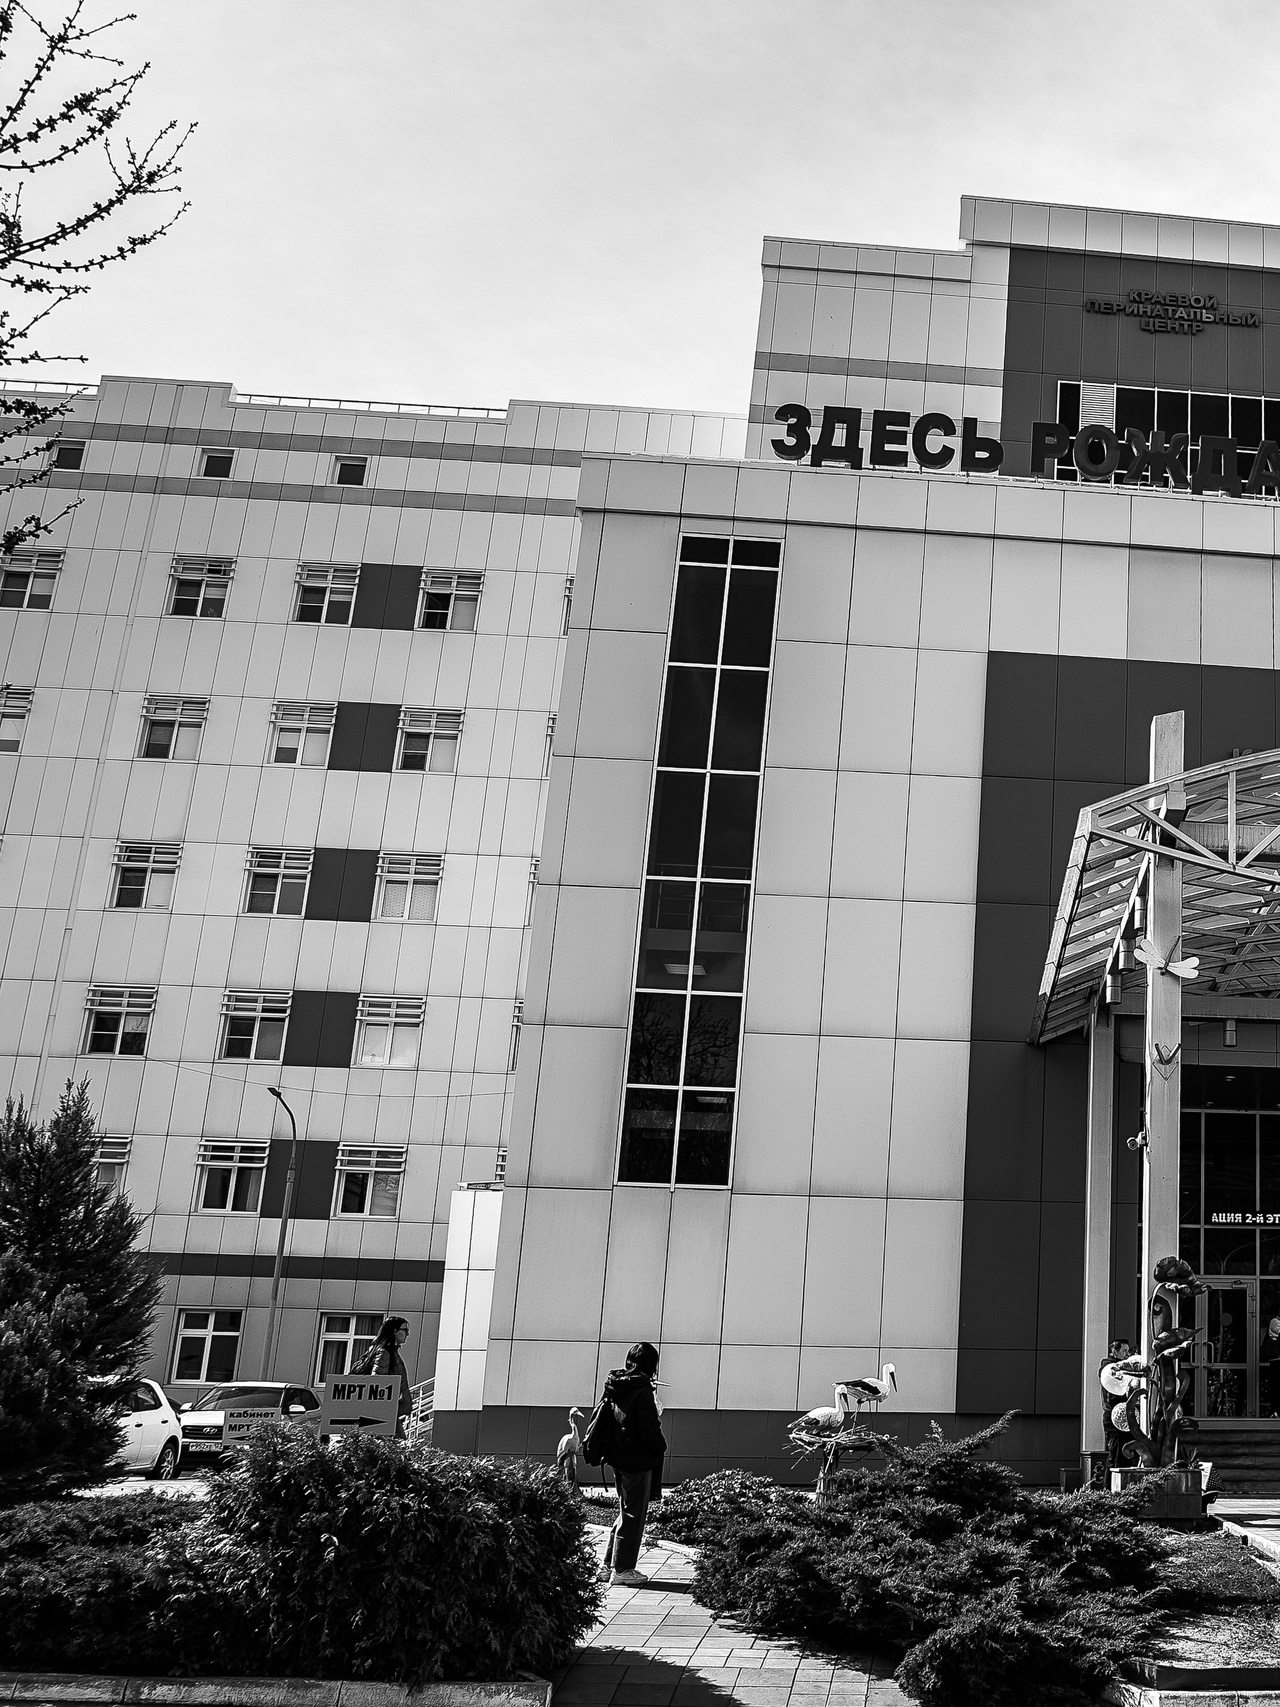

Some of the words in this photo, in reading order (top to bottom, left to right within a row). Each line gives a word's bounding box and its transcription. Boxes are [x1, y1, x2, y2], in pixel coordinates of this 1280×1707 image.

[1128, 289, 1218, 309] КРАЕВОЙ
[1085, 299, 1261, 328] ПЕРИНАТАЛЬНЫЙ
[1140, 318, 1204, 335] ЦЕНТР
[771, 403, 1004, 473] ЗДЕСЬ
[332, 1384, 366, 1400] МРТ
[368, 1384, 394, 1400] №1
[228, 1410, 275, 1419] кабинет
[228, 1424, 252, 1432] МРТ
